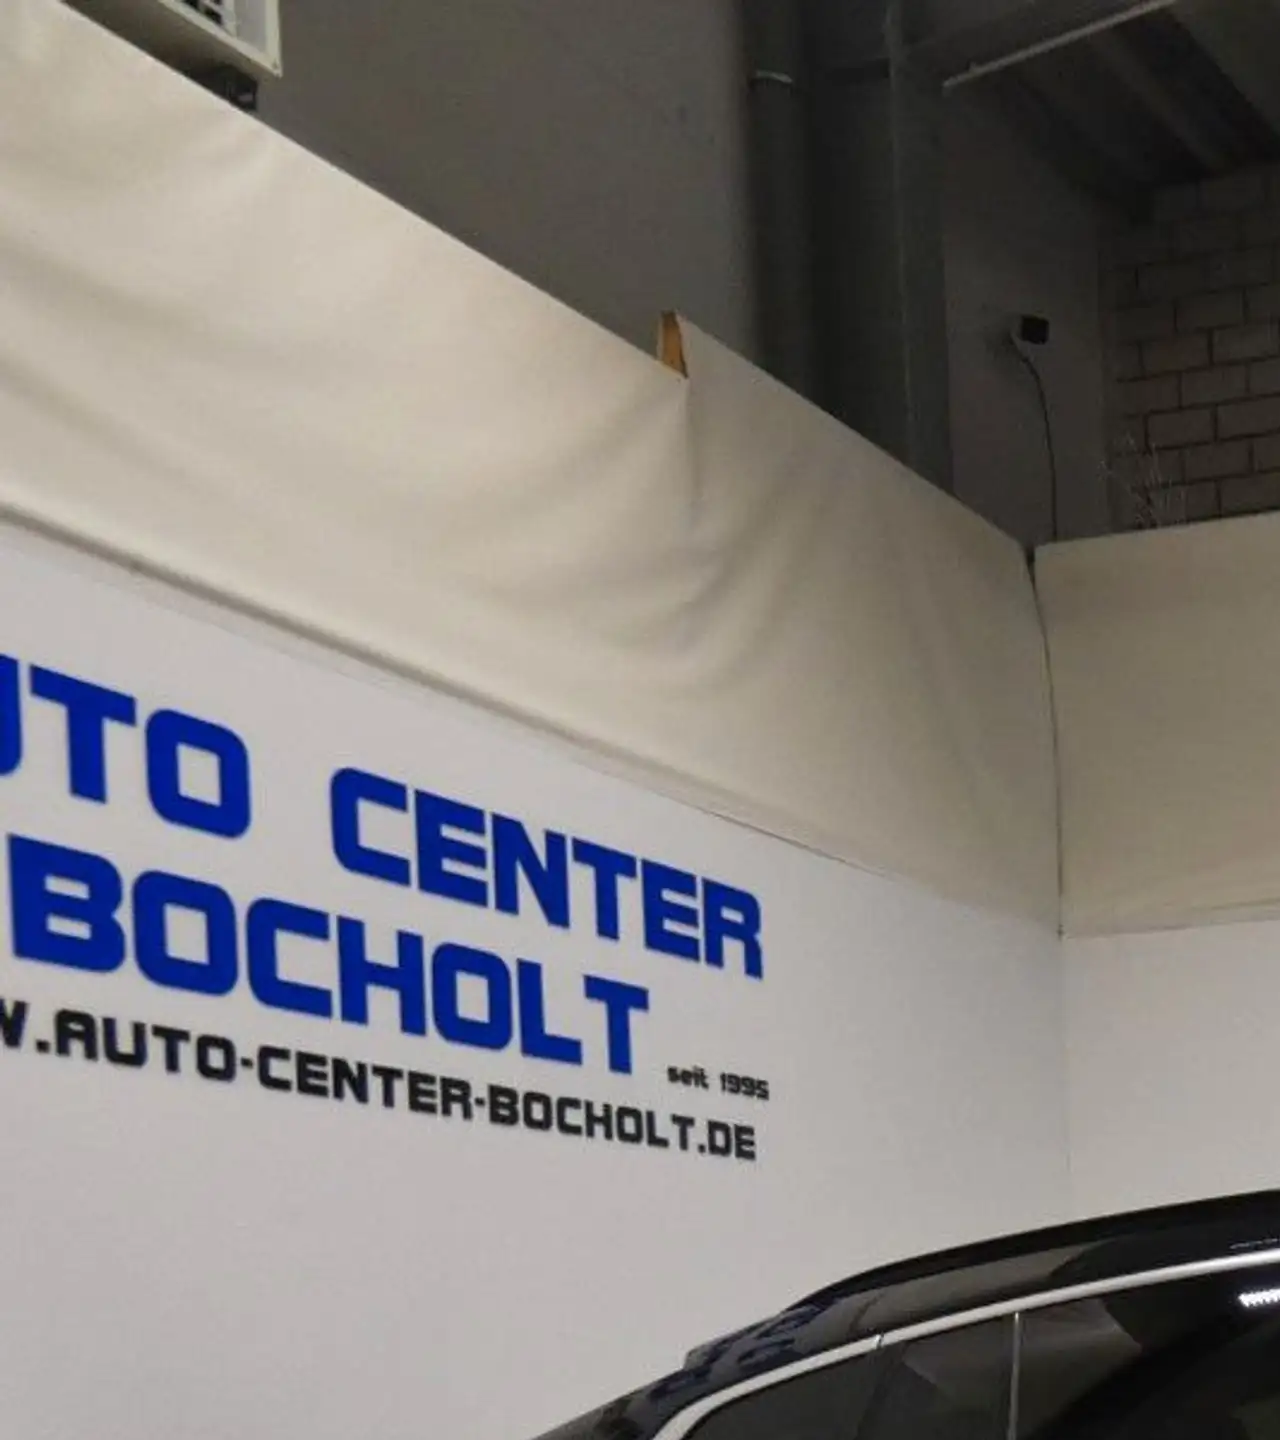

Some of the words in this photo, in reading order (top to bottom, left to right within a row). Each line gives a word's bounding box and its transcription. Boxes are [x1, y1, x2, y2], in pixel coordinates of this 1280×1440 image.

[0, 655, 252, 838] TO
[330, 768, 763, 978] CENTER
[8, 835, 648, 1073] BOCHOLT
[667, 1065, 709, 1090] seit
[719, 1072, 770, 1101] 1995
